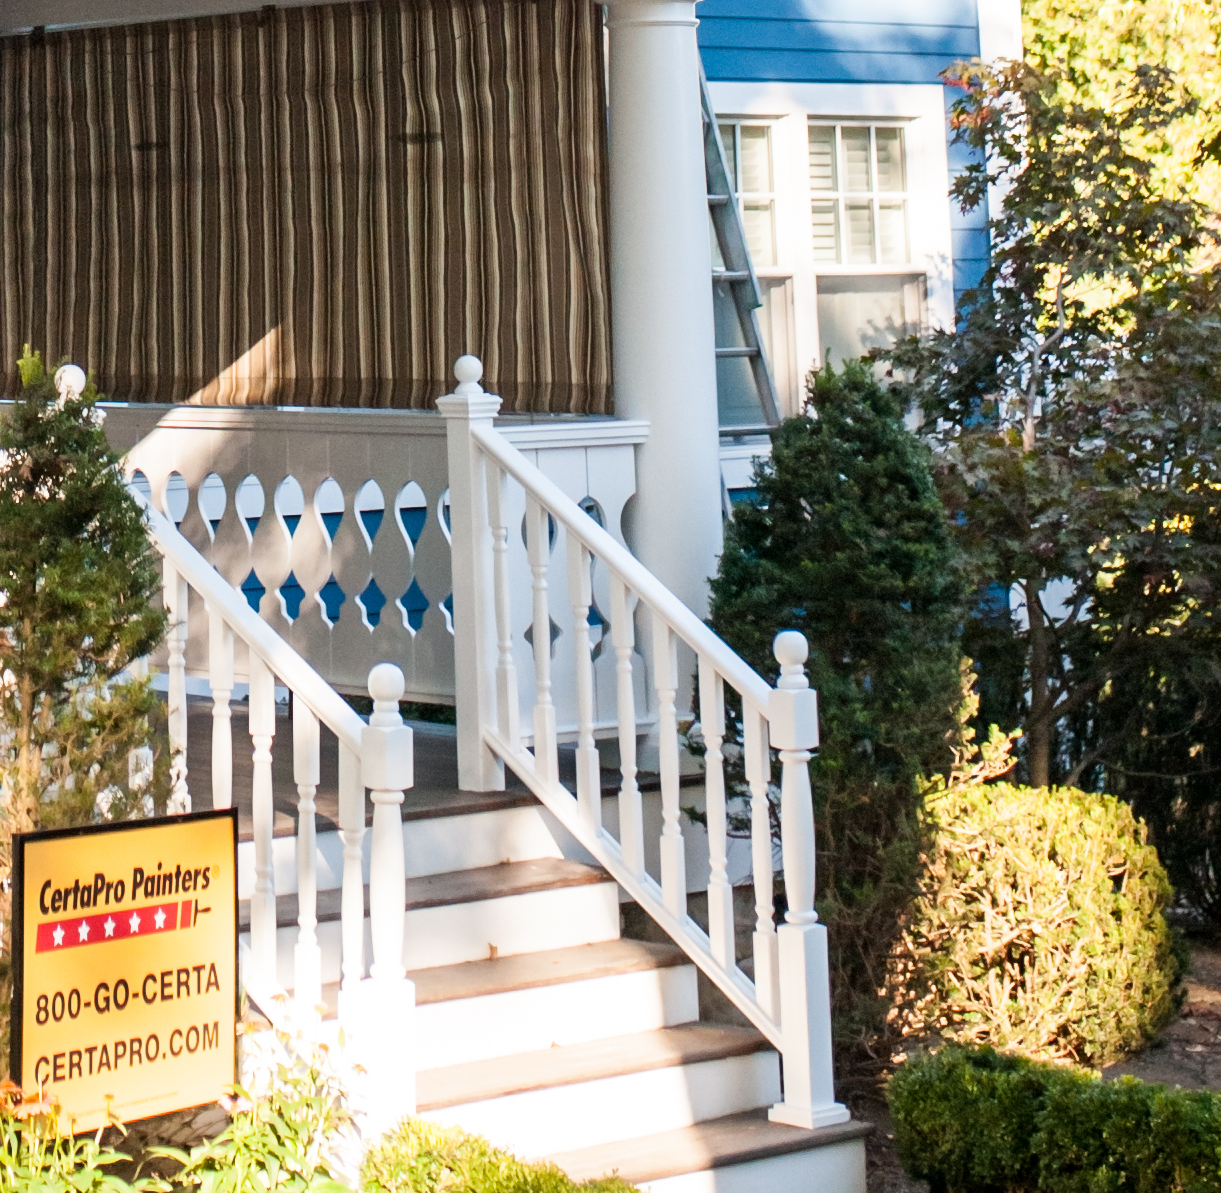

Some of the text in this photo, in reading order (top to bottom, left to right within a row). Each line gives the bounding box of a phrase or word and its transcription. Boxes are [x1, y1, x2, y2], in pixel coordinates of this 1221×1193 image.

[39, 861, 211, 915] CertaPro Painters
[35, 962, 220, 1026] 800-GO-CERTA
[34, 1021, 220, 1086] CERTAPRO.COM
